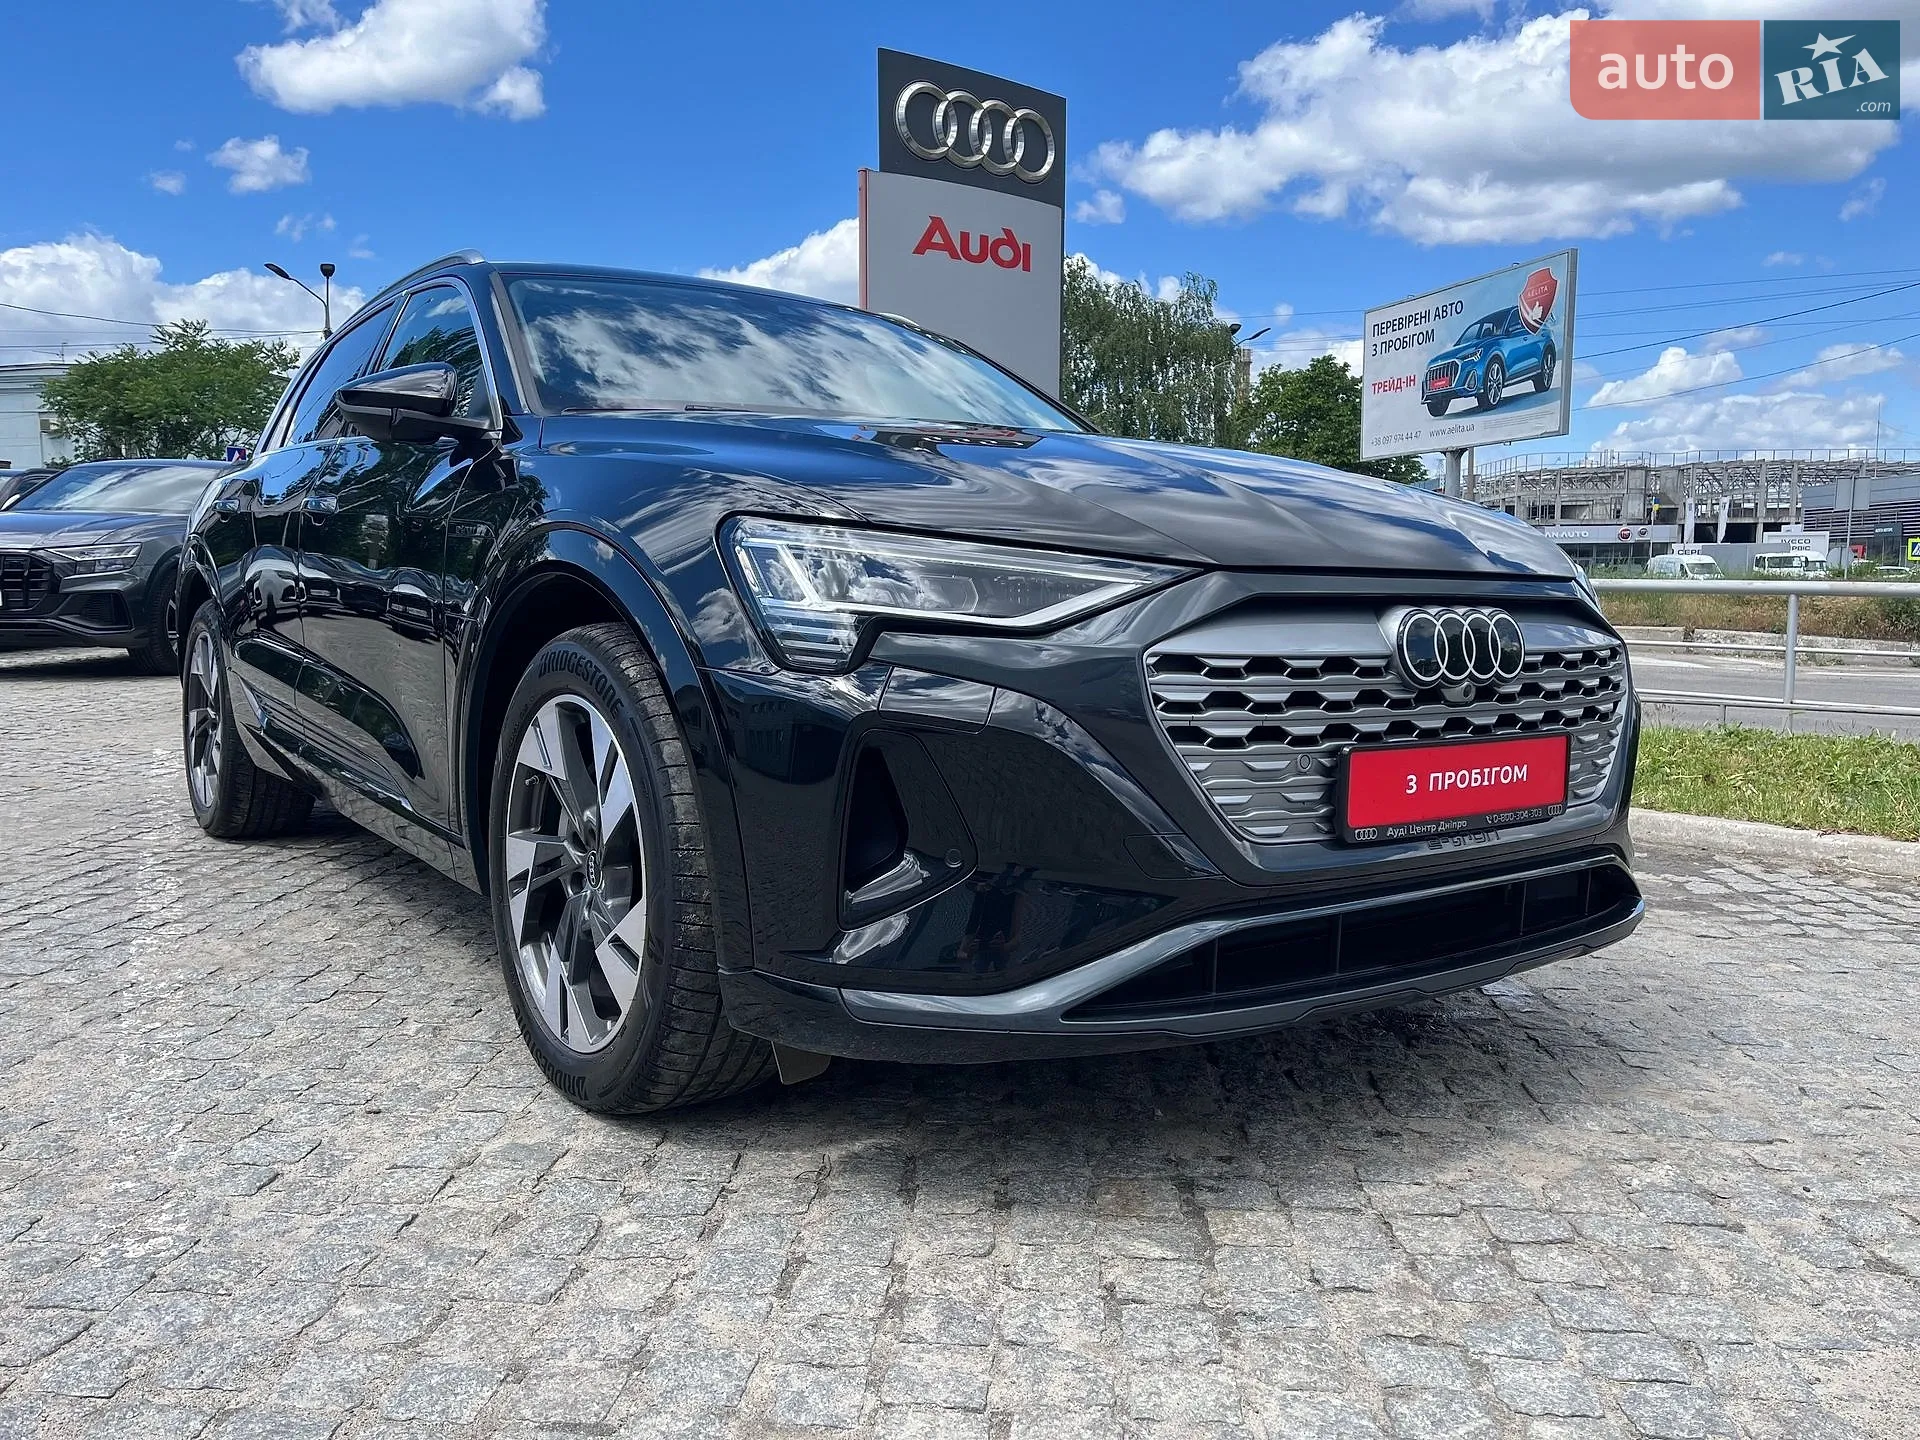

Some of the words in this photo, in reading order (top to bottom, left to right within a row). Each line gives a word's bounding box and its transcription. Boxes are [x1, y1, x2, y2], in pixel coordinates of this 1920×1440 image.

[912, 215, 1031, 273] Audi
[1372, 309, 1431, 338] ПЕРЕВІРЕНІ
[1433, 300, 1464, 321] АВТО
[1371, 343, 1378, 357] З
[1380, 329, 1435, 356] ПРОБІГОМ
[1372, 375, 1416, 395] ТРЕЙД-ІН
[1382, 435, 1393, 445] 097
[1394, 433, 1404, 443] 974
[1405, 431, 1413, 441] 44
[1413, 430, 1422, 439] 47
[1429, 423, 1475, 438] www.aelita.ua
[539, 649, 624, 719] BRIDGESTONE
[1428, 764, 1528, 791] ПРОБІГОМ
[1493, 808, 1542, 823] 0-800-304-303
[1386, 825, 1408, 838] Ауді
[1408, 822, 1437, 836] Центр
[1439, 818, 1467, 832] Дніпро
